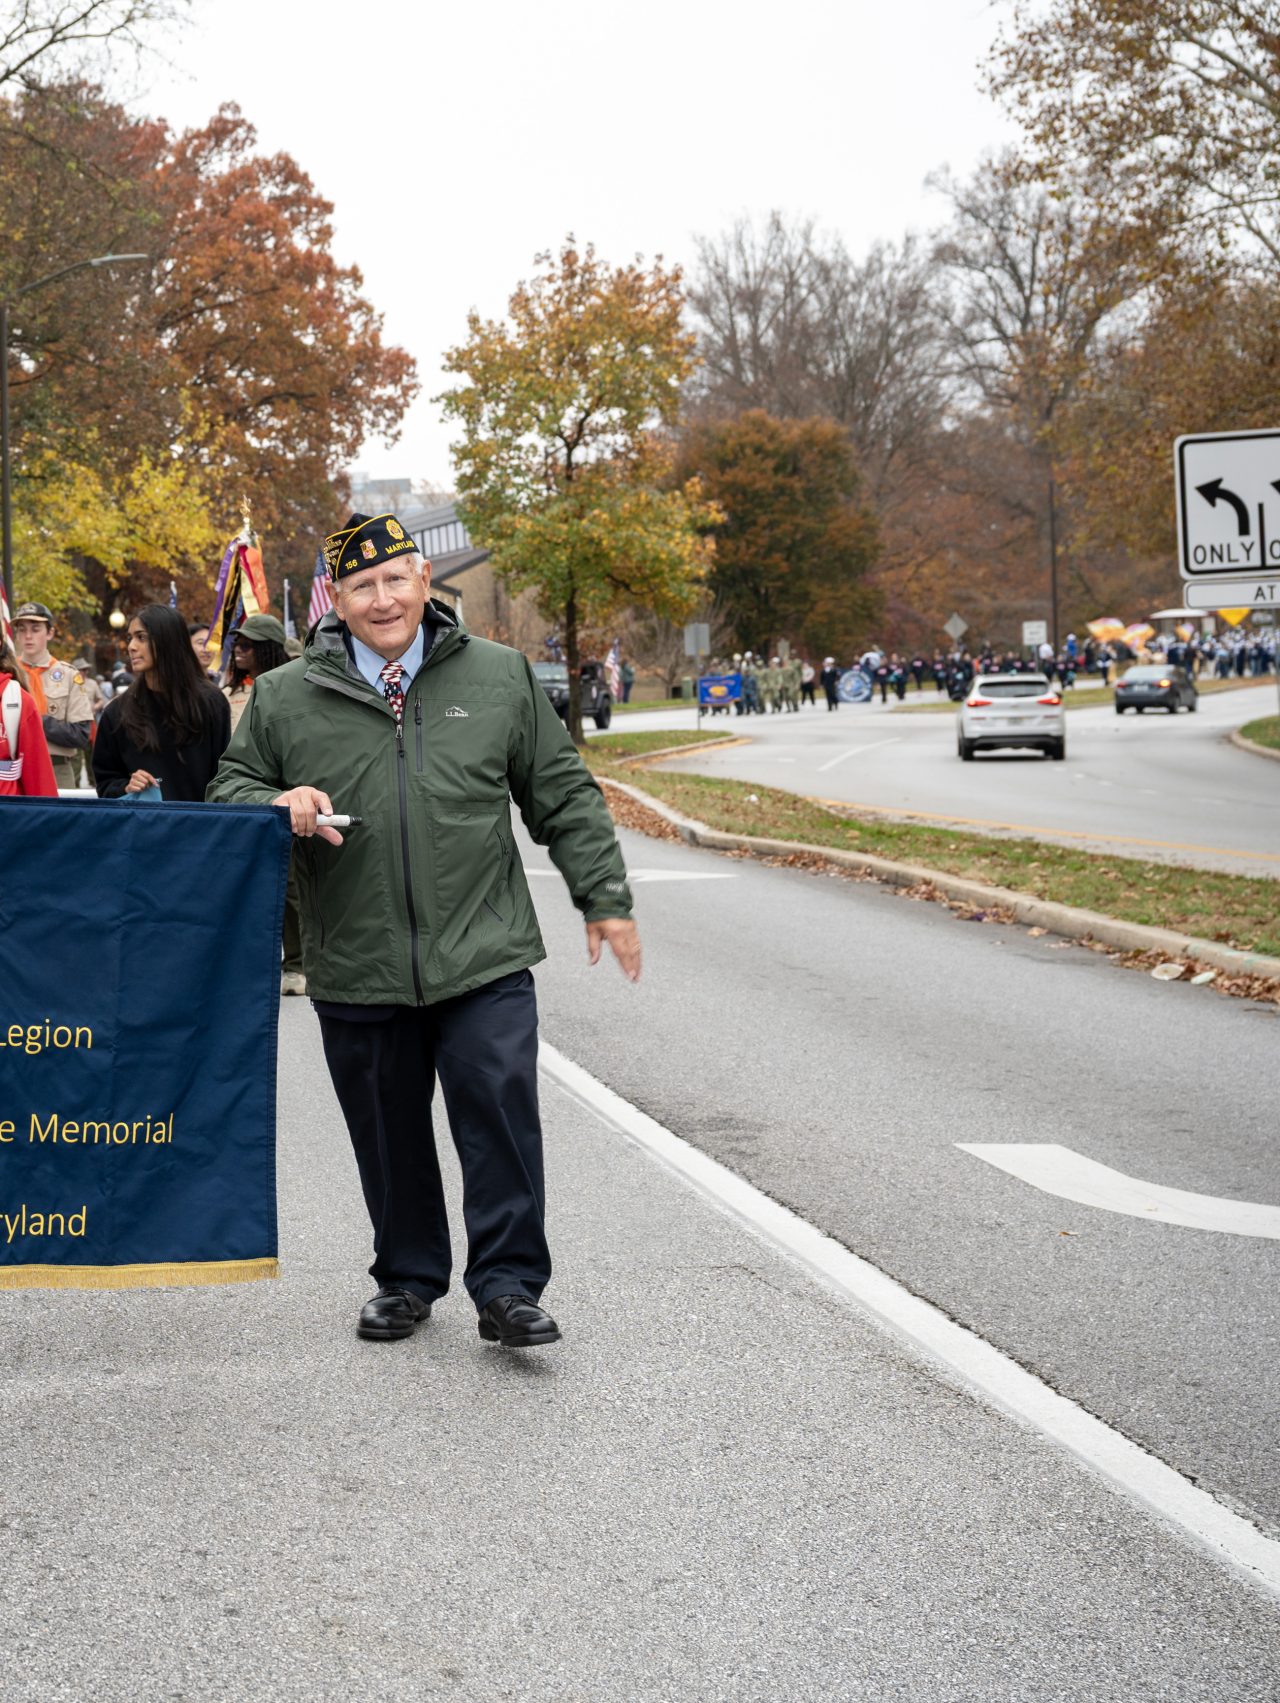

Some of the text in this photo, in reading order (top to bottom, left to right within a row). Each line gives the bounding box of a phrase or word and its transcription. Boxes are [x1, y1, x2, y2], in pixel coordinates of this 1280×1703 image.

[1193, 541, 1255, 565] ONLY
[1254, 584, 1277, 601] AT
[29, 1112, 174, 1145] Memorial
